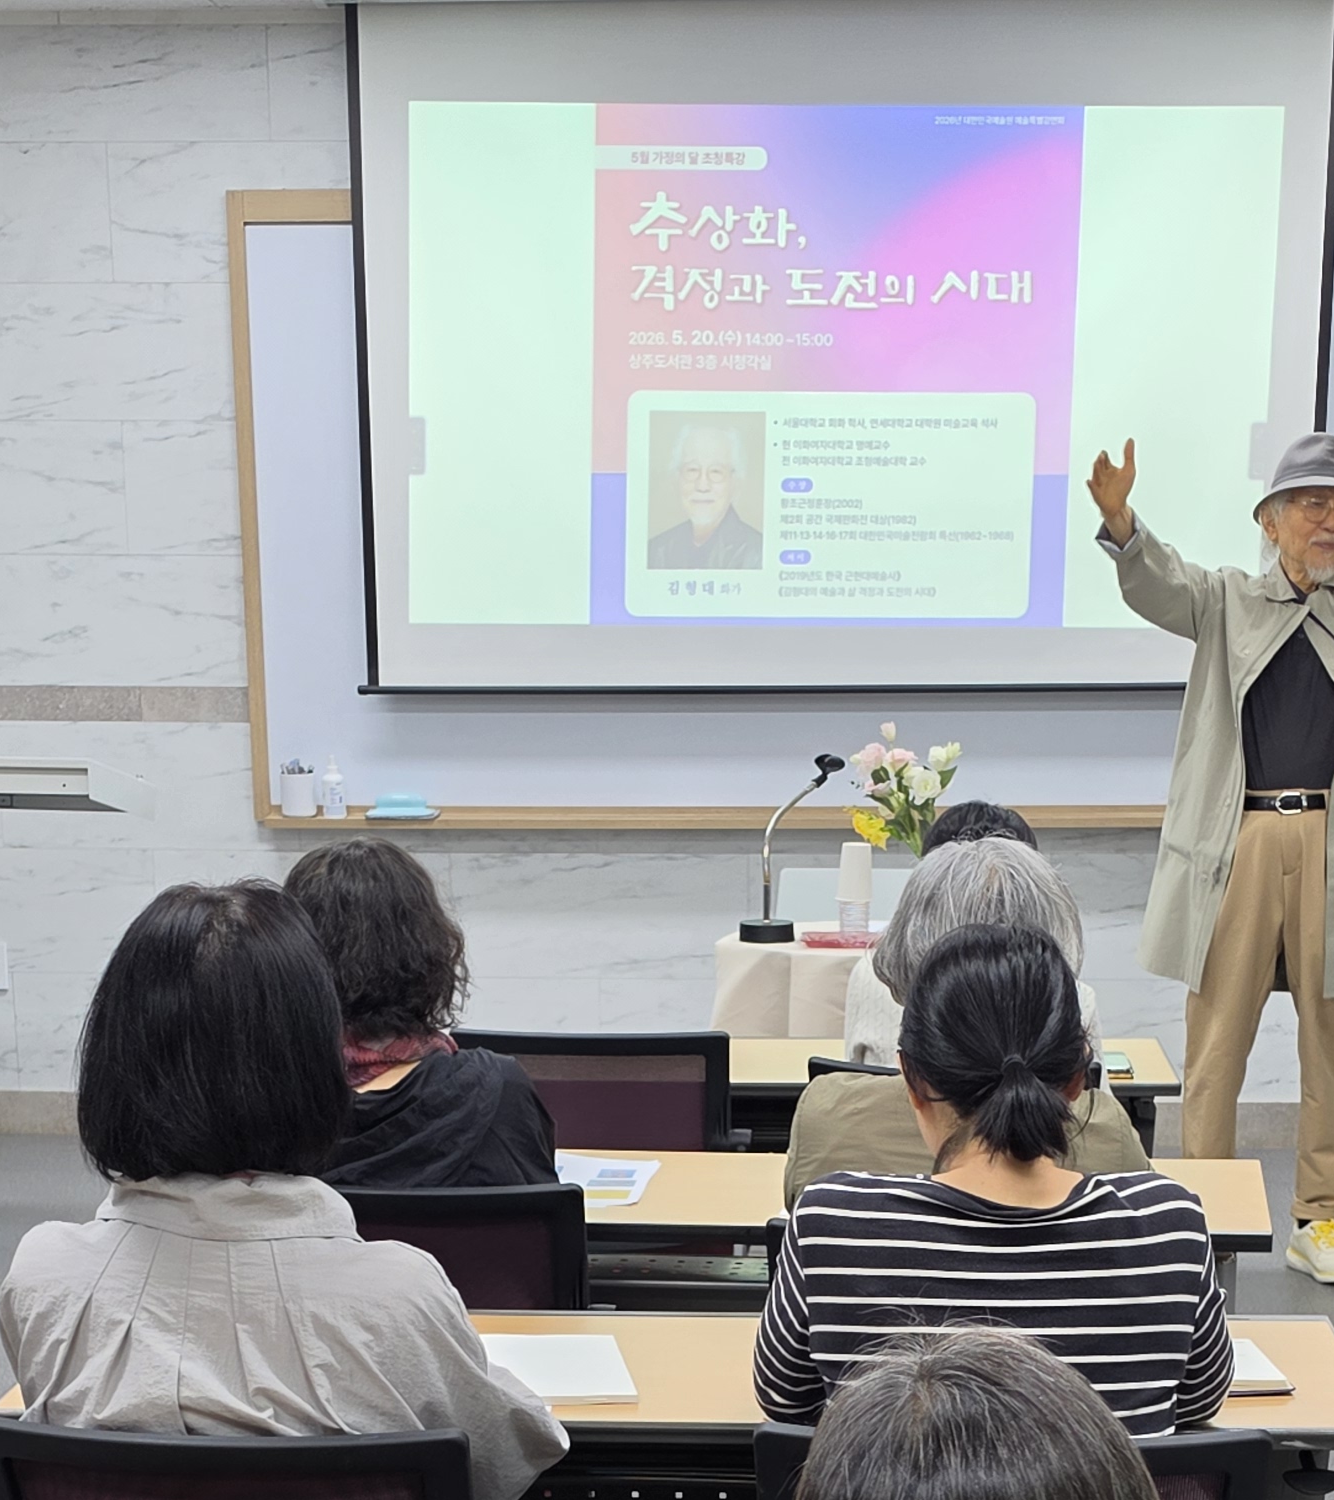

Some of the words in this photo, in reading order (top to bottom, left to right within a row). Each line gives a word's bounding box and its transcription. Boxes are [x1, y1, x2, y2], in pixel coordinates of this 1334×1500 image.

[631, 151, 650, 165] 5월
[701, 151, 746, 165] 초청특강
[629, 191, 807, 251] 추상화,
[630, 265, 770, 311] 격정과
[785, 268, 915, 309] 도전의
[930, 271, 1034, 305] 시대
[745, 331, 784, 346] 14:00
[628, 354, 692, 370] 상주도서관
[696, 354, 717, 370] 3층
[721, 354, 772, 370] 시청각실
